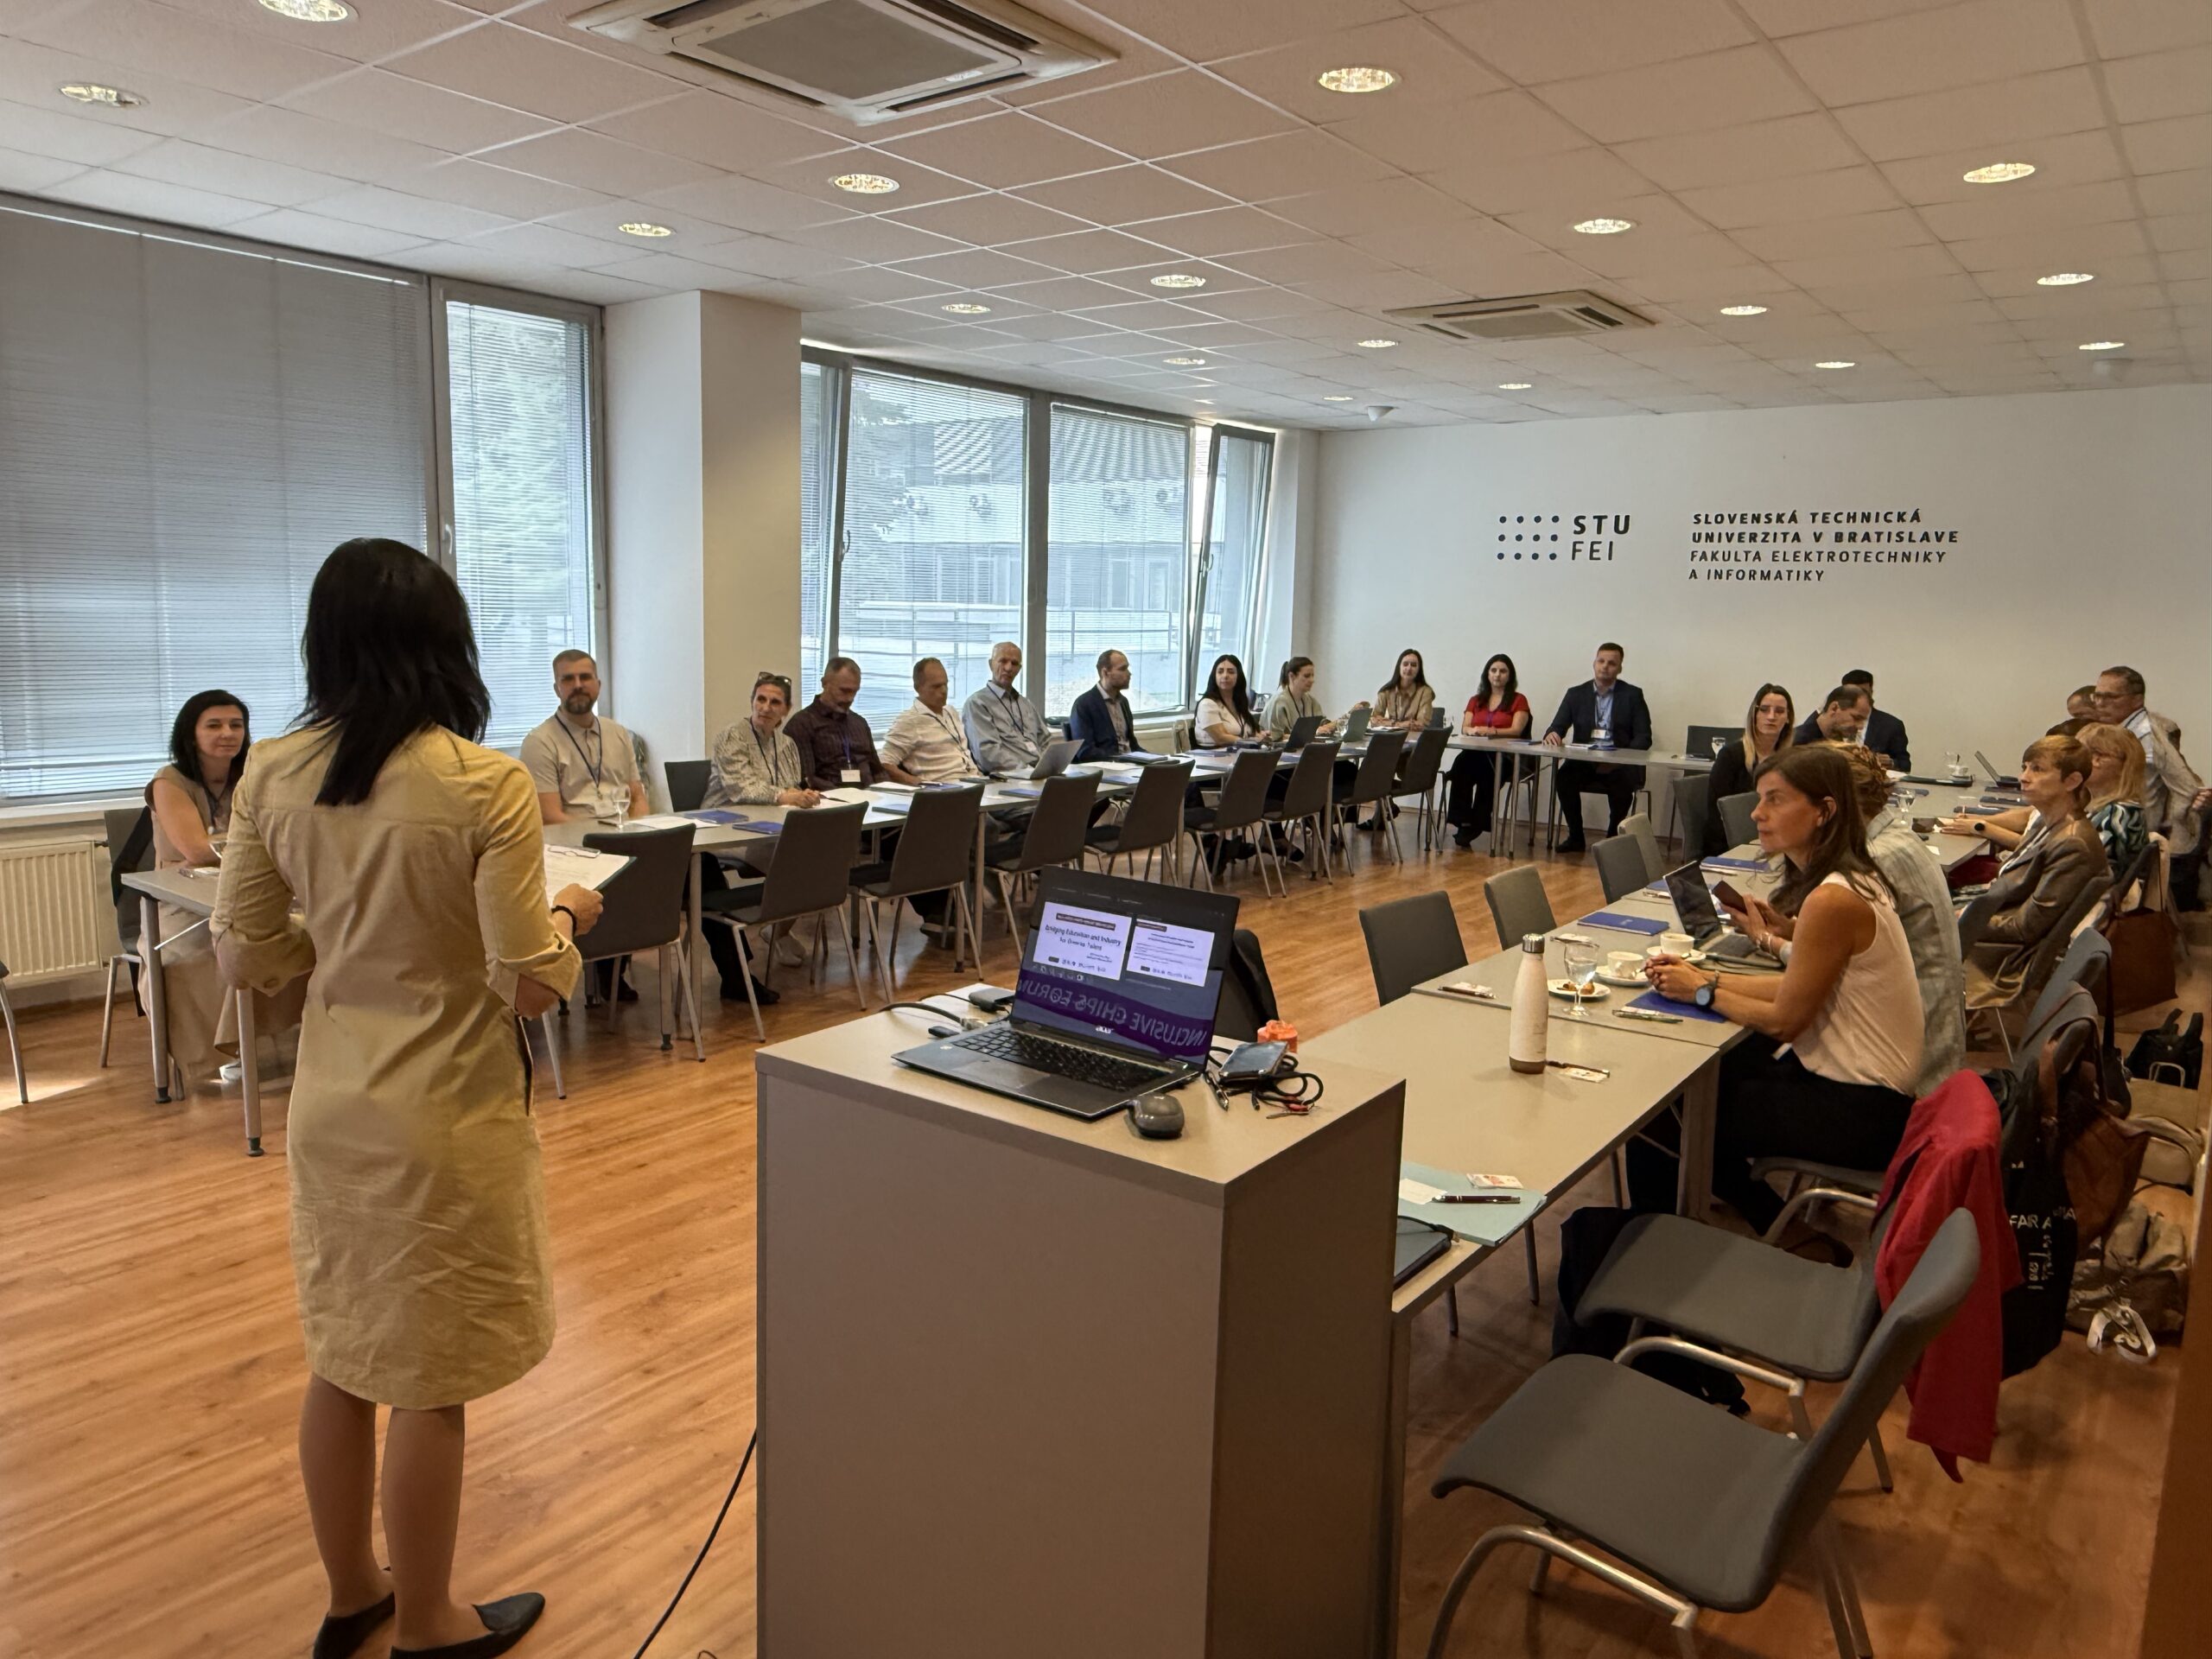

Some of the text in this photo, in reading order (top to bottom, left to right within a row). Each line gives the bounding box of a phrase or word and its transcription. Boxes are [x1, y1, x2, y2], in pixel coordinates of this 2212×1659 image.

[1692, 507, 1922, 526] SLOVENSKÁ TECHNICKÁ
[1572, 514, 1631, 536] STU
[1691, 531, 1960, 544] UNIVERZITA V BRATISLAVE
[1571, 540, 1614, 562] FEI
[1689, 550, 1947, 563] FAKULTA ELEKTROTECHNIKY
[1688, 568, 1825, 582] A INFORMATIKY
